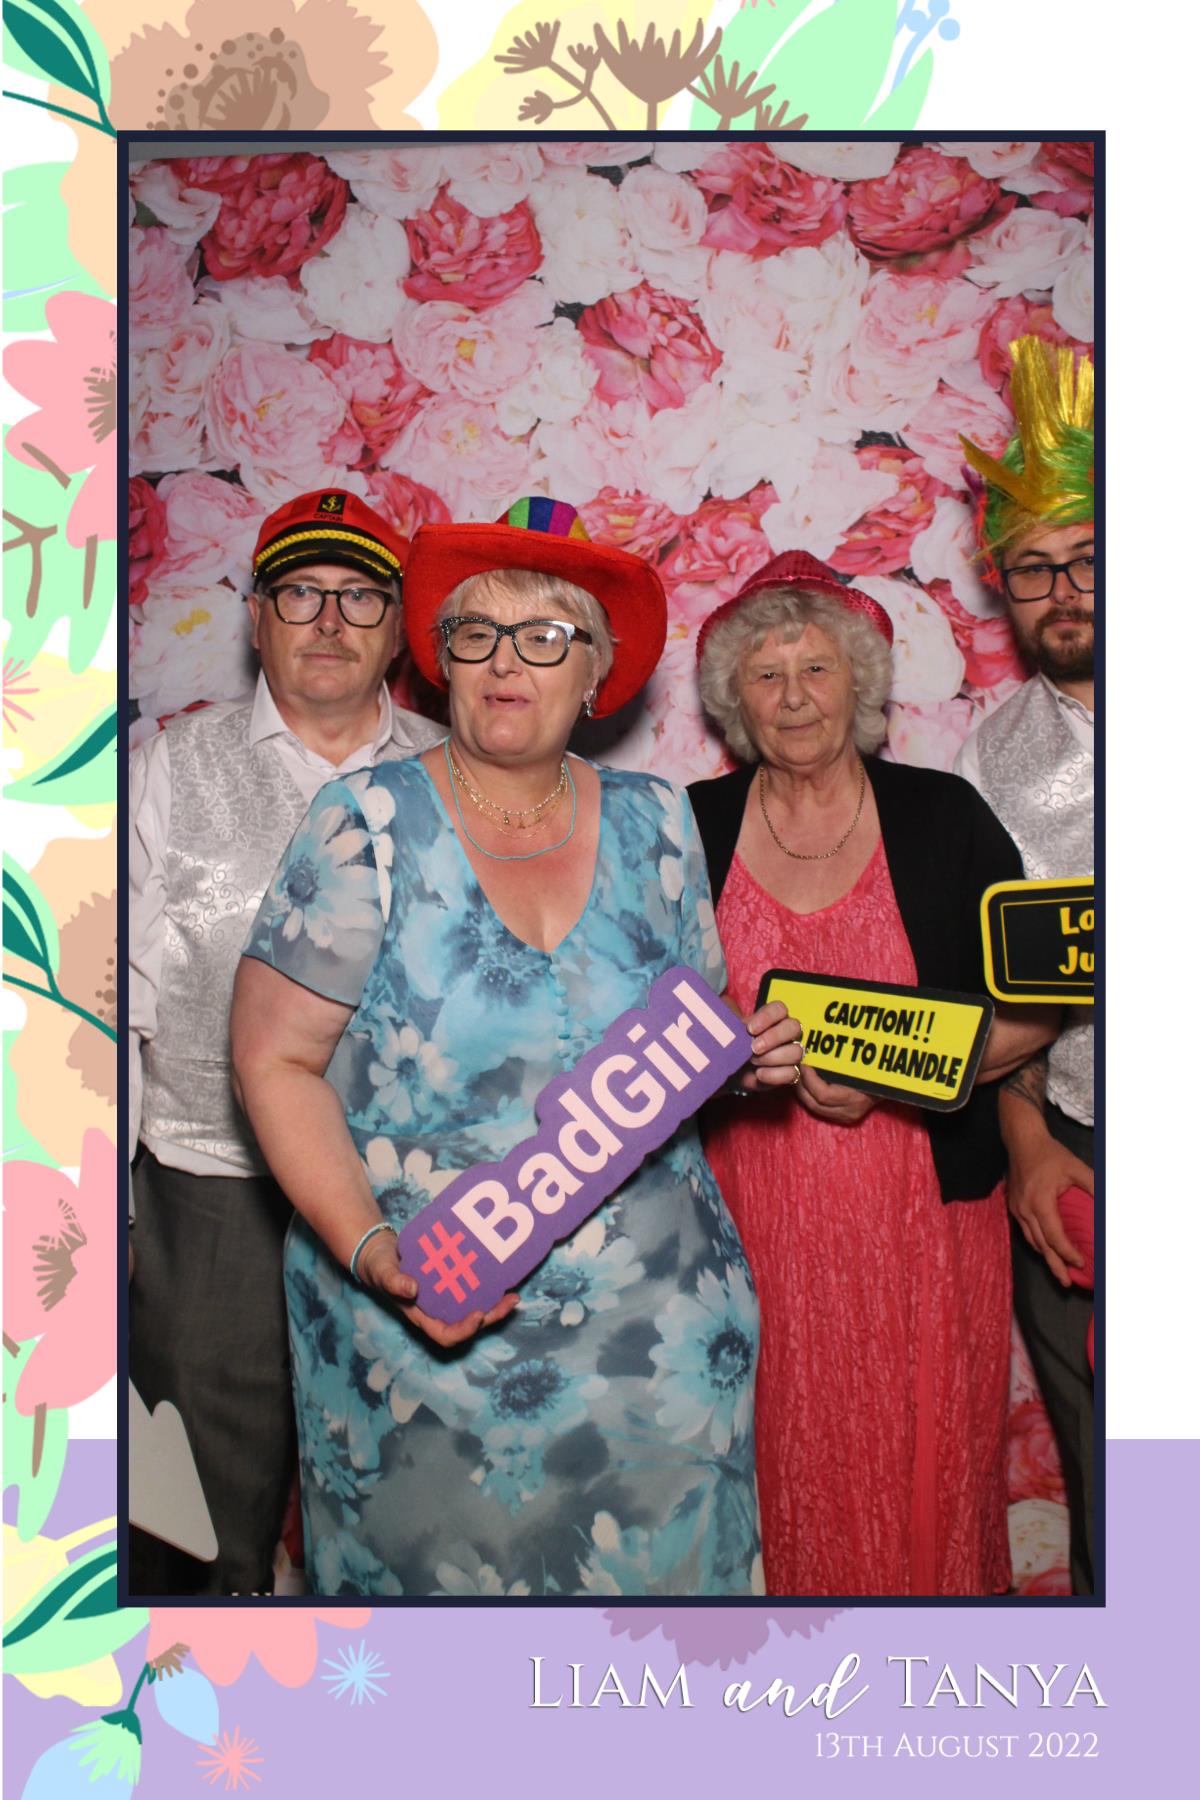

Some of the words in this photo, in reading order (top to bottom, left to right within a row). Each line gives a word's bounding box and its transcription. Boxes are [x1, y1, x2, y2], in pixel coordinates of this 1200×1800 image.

[824, 1001, 936, 1044] CAUTION!!
[805, 1029, 849, 1058] HOT
[851, 1037, 877, 1065] TO
[878, 1044, 963, 1089] HANDLE
[418, 980, 736, 1304] #BadGirl
